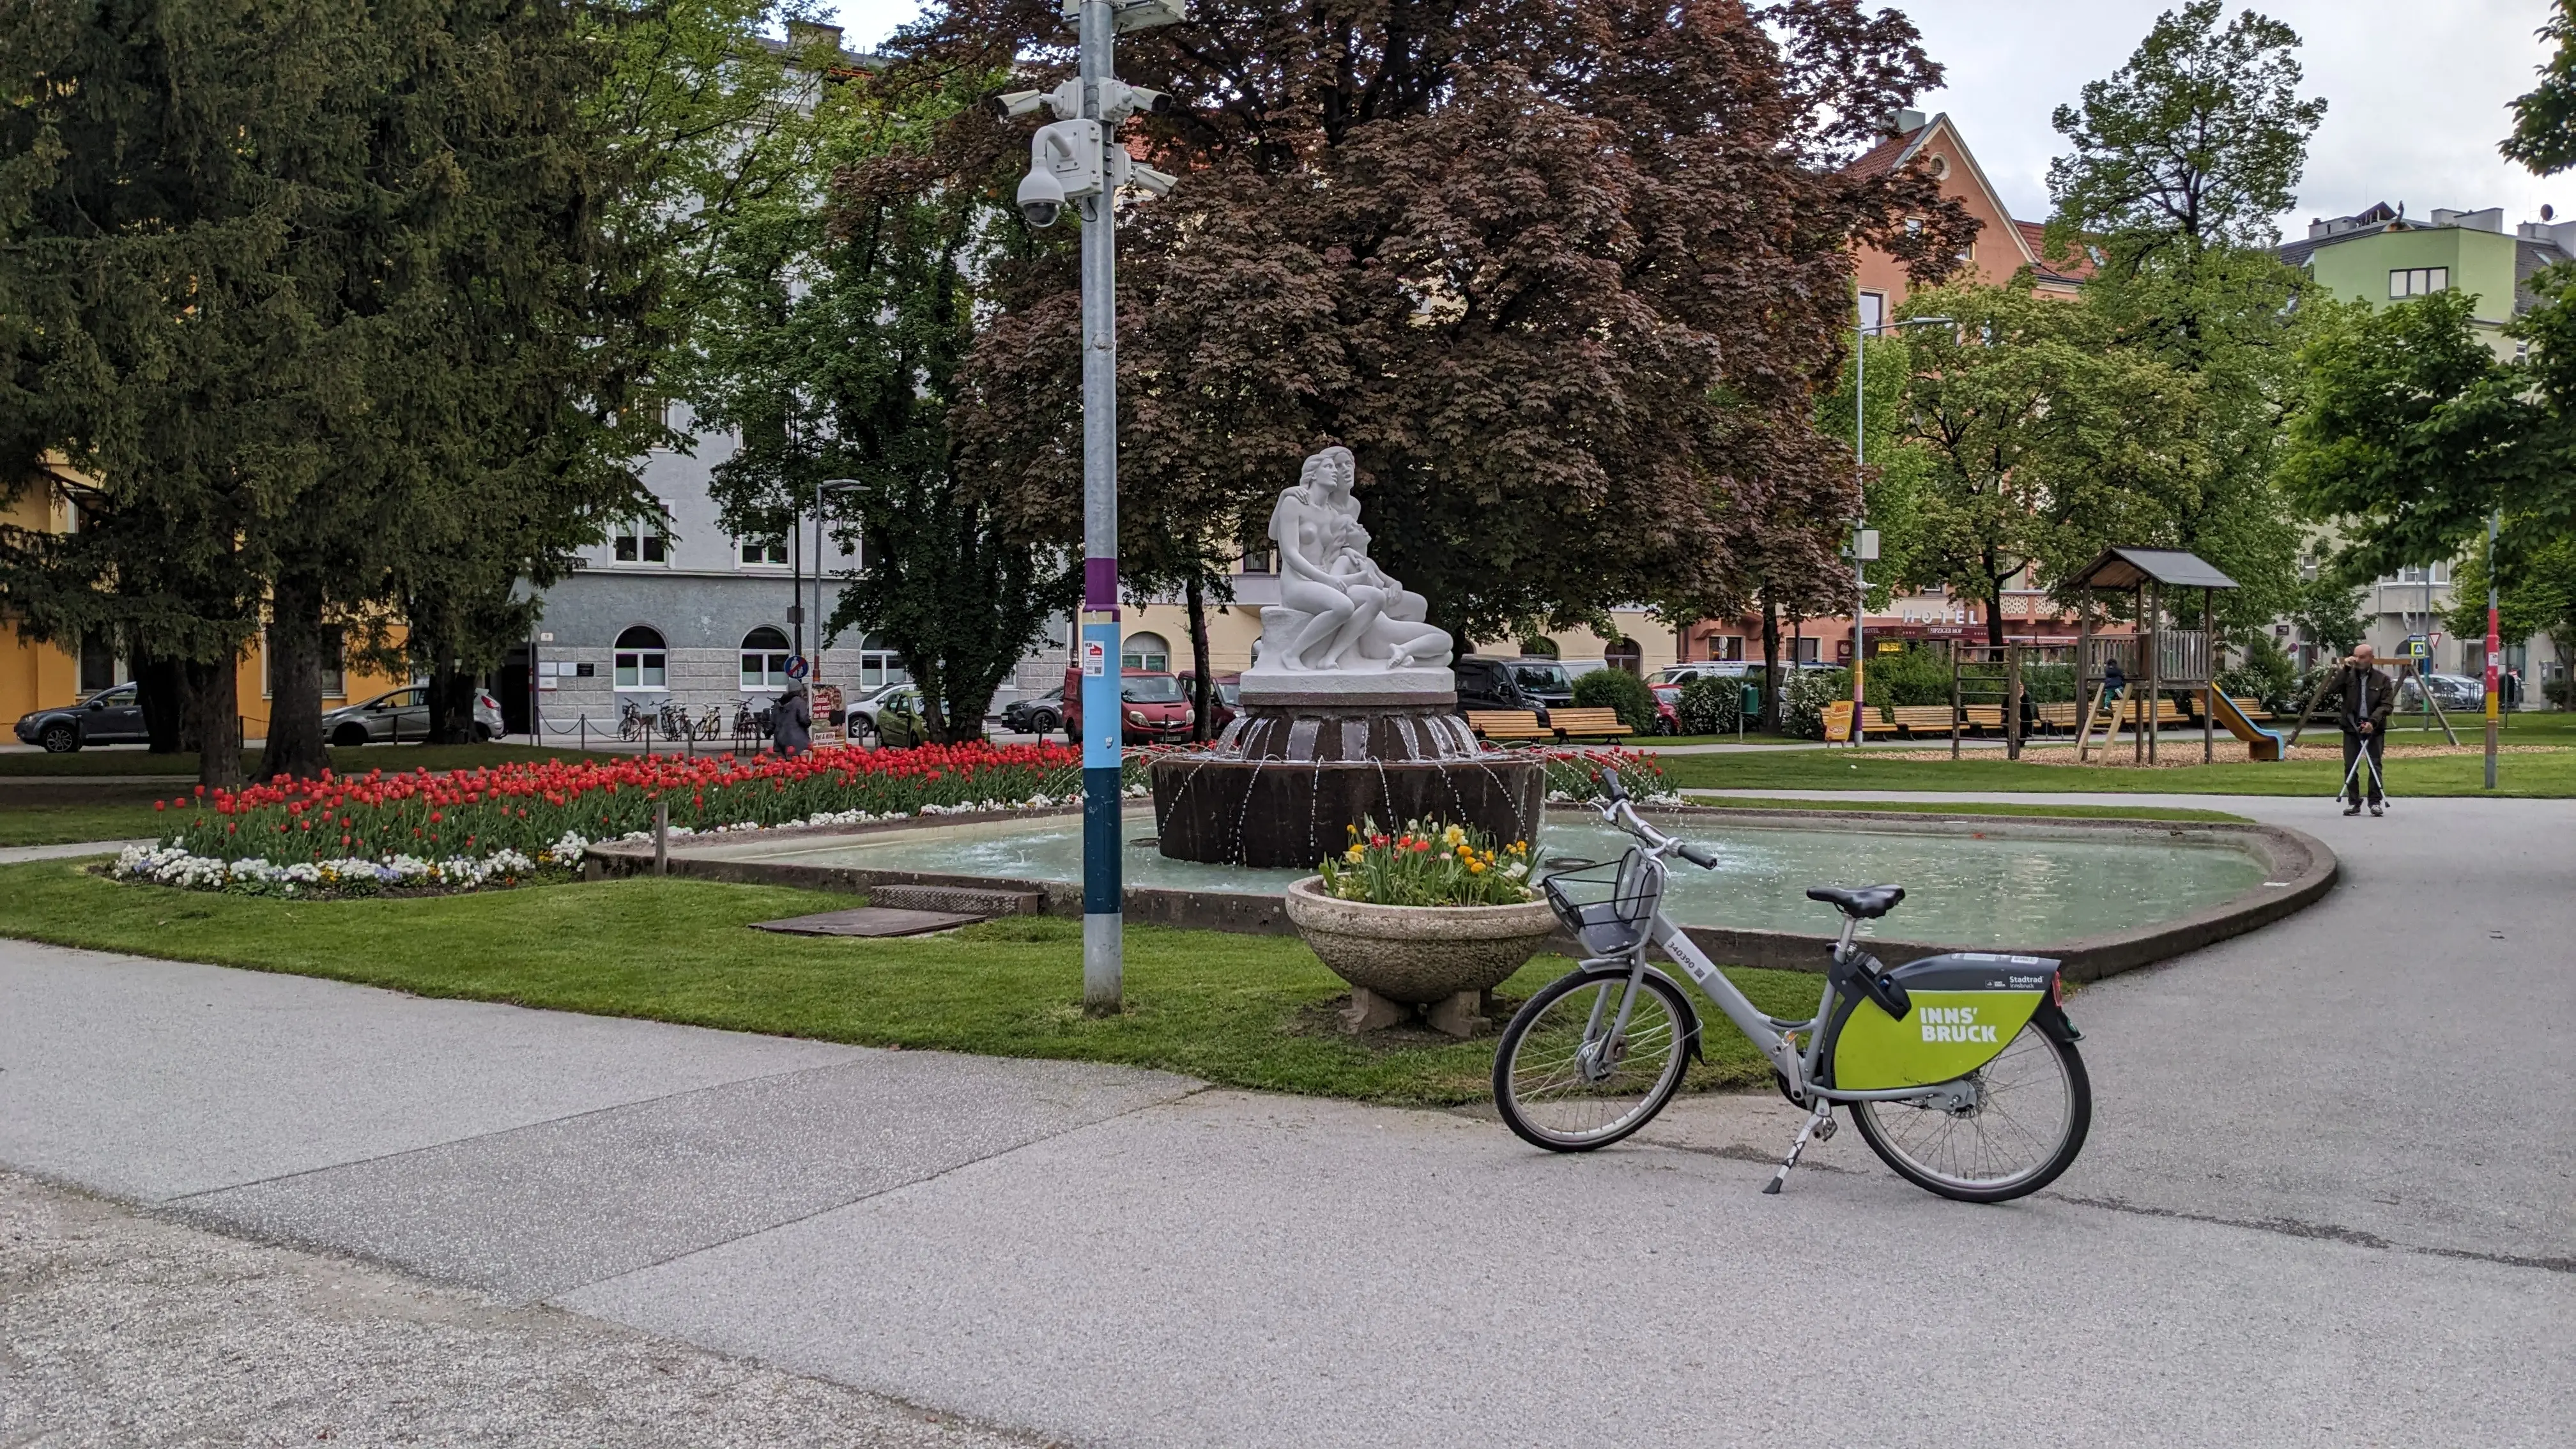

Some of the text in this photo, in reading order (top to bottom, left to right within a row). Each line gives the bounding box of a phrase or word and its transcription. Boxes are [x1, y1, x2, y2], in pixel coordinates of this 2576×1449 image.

[1903, 609, 1978, 624] HOTEL
[1668, 941, 1695, 968] 340390
[1919, 1007, 1978, 1024] INNS'
[1920, 1025, 1998, 1043] BRUCK
